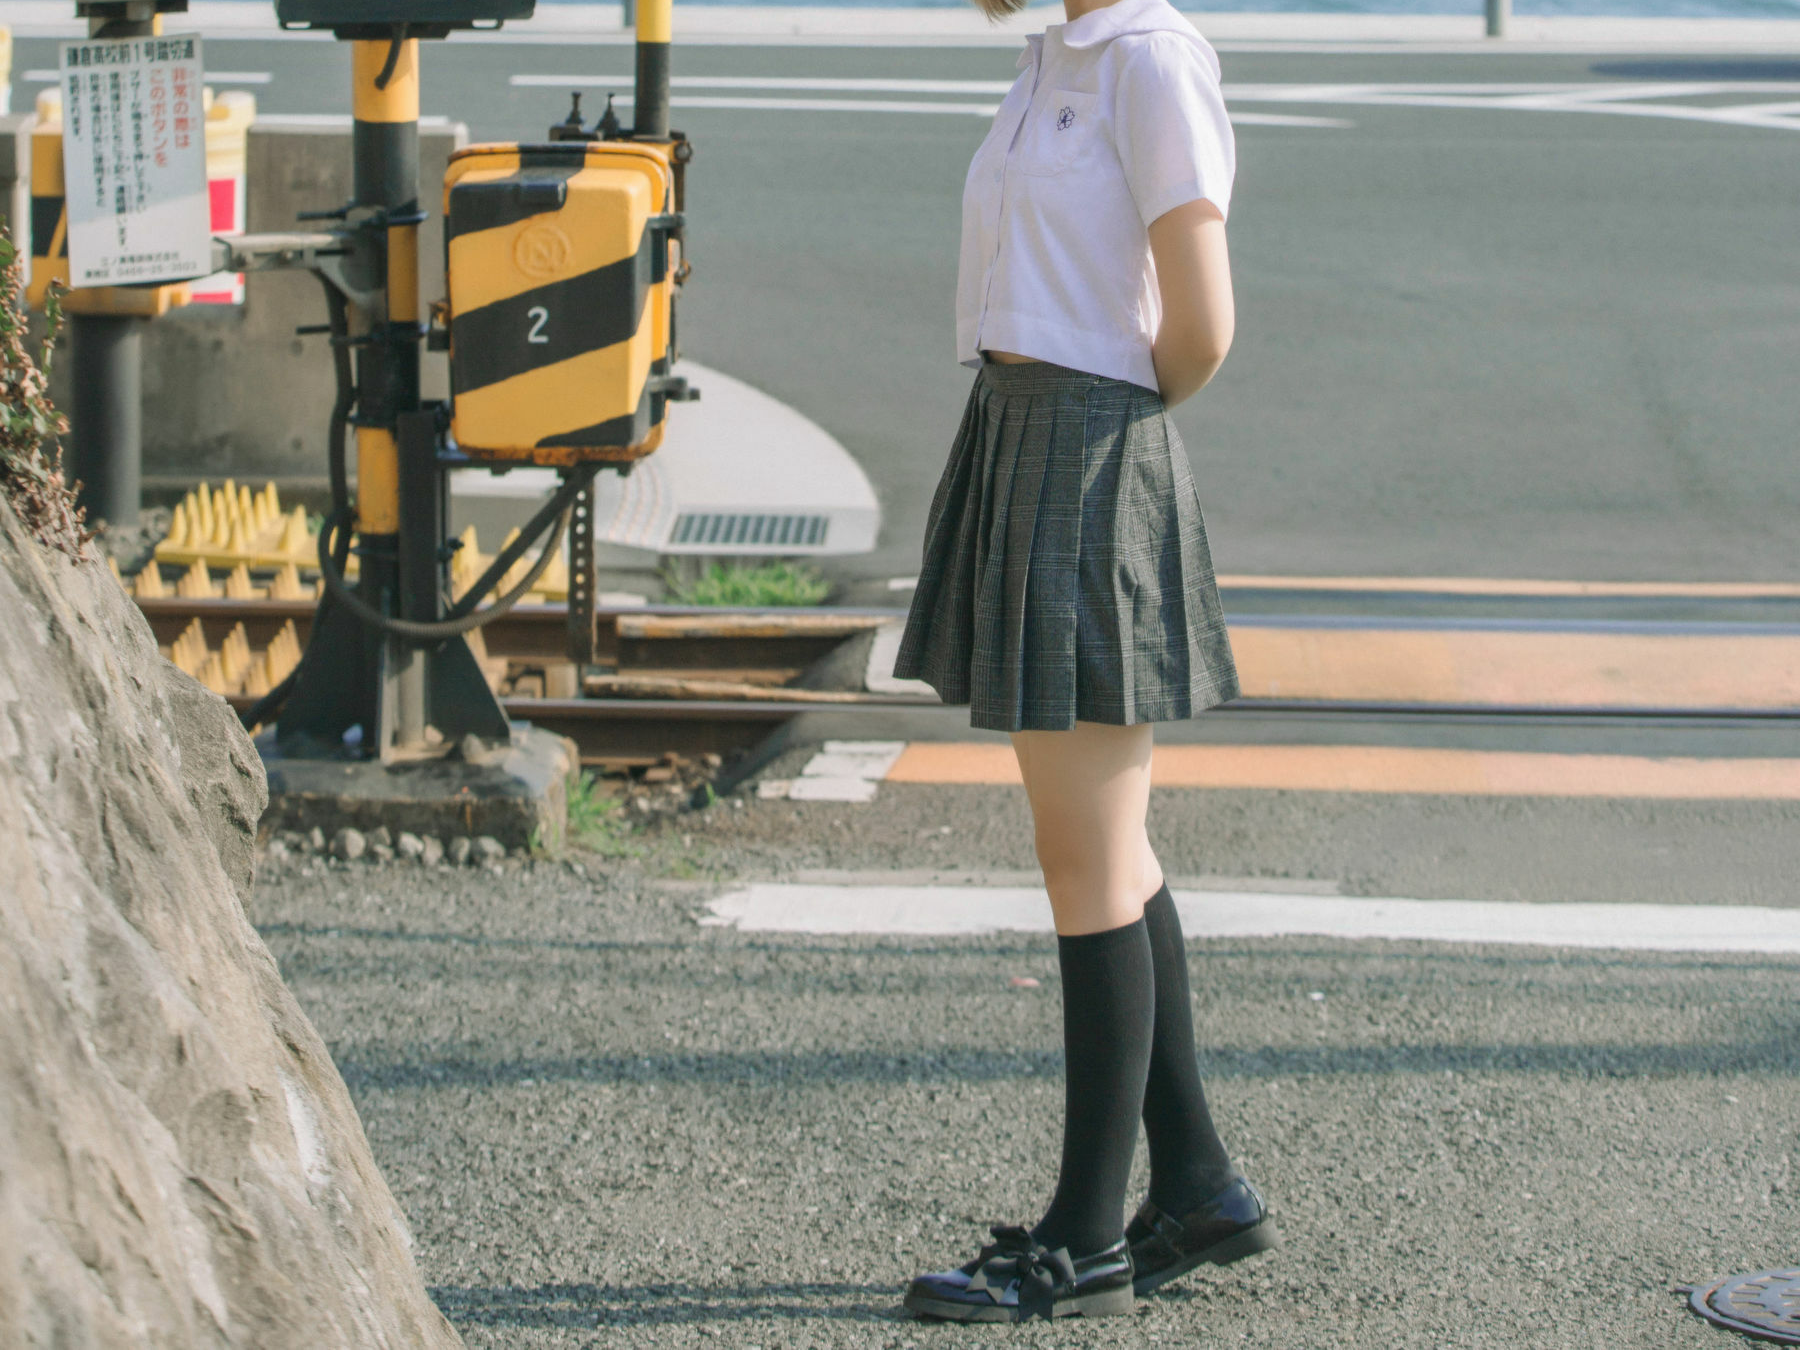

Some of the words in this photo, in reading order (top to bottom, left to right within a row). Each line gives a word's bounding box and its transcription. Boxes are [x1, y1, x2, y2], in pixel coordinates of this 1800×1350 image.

[150, 68, 169, 168] このボタンを
[528, 306, 549, 343] 2
